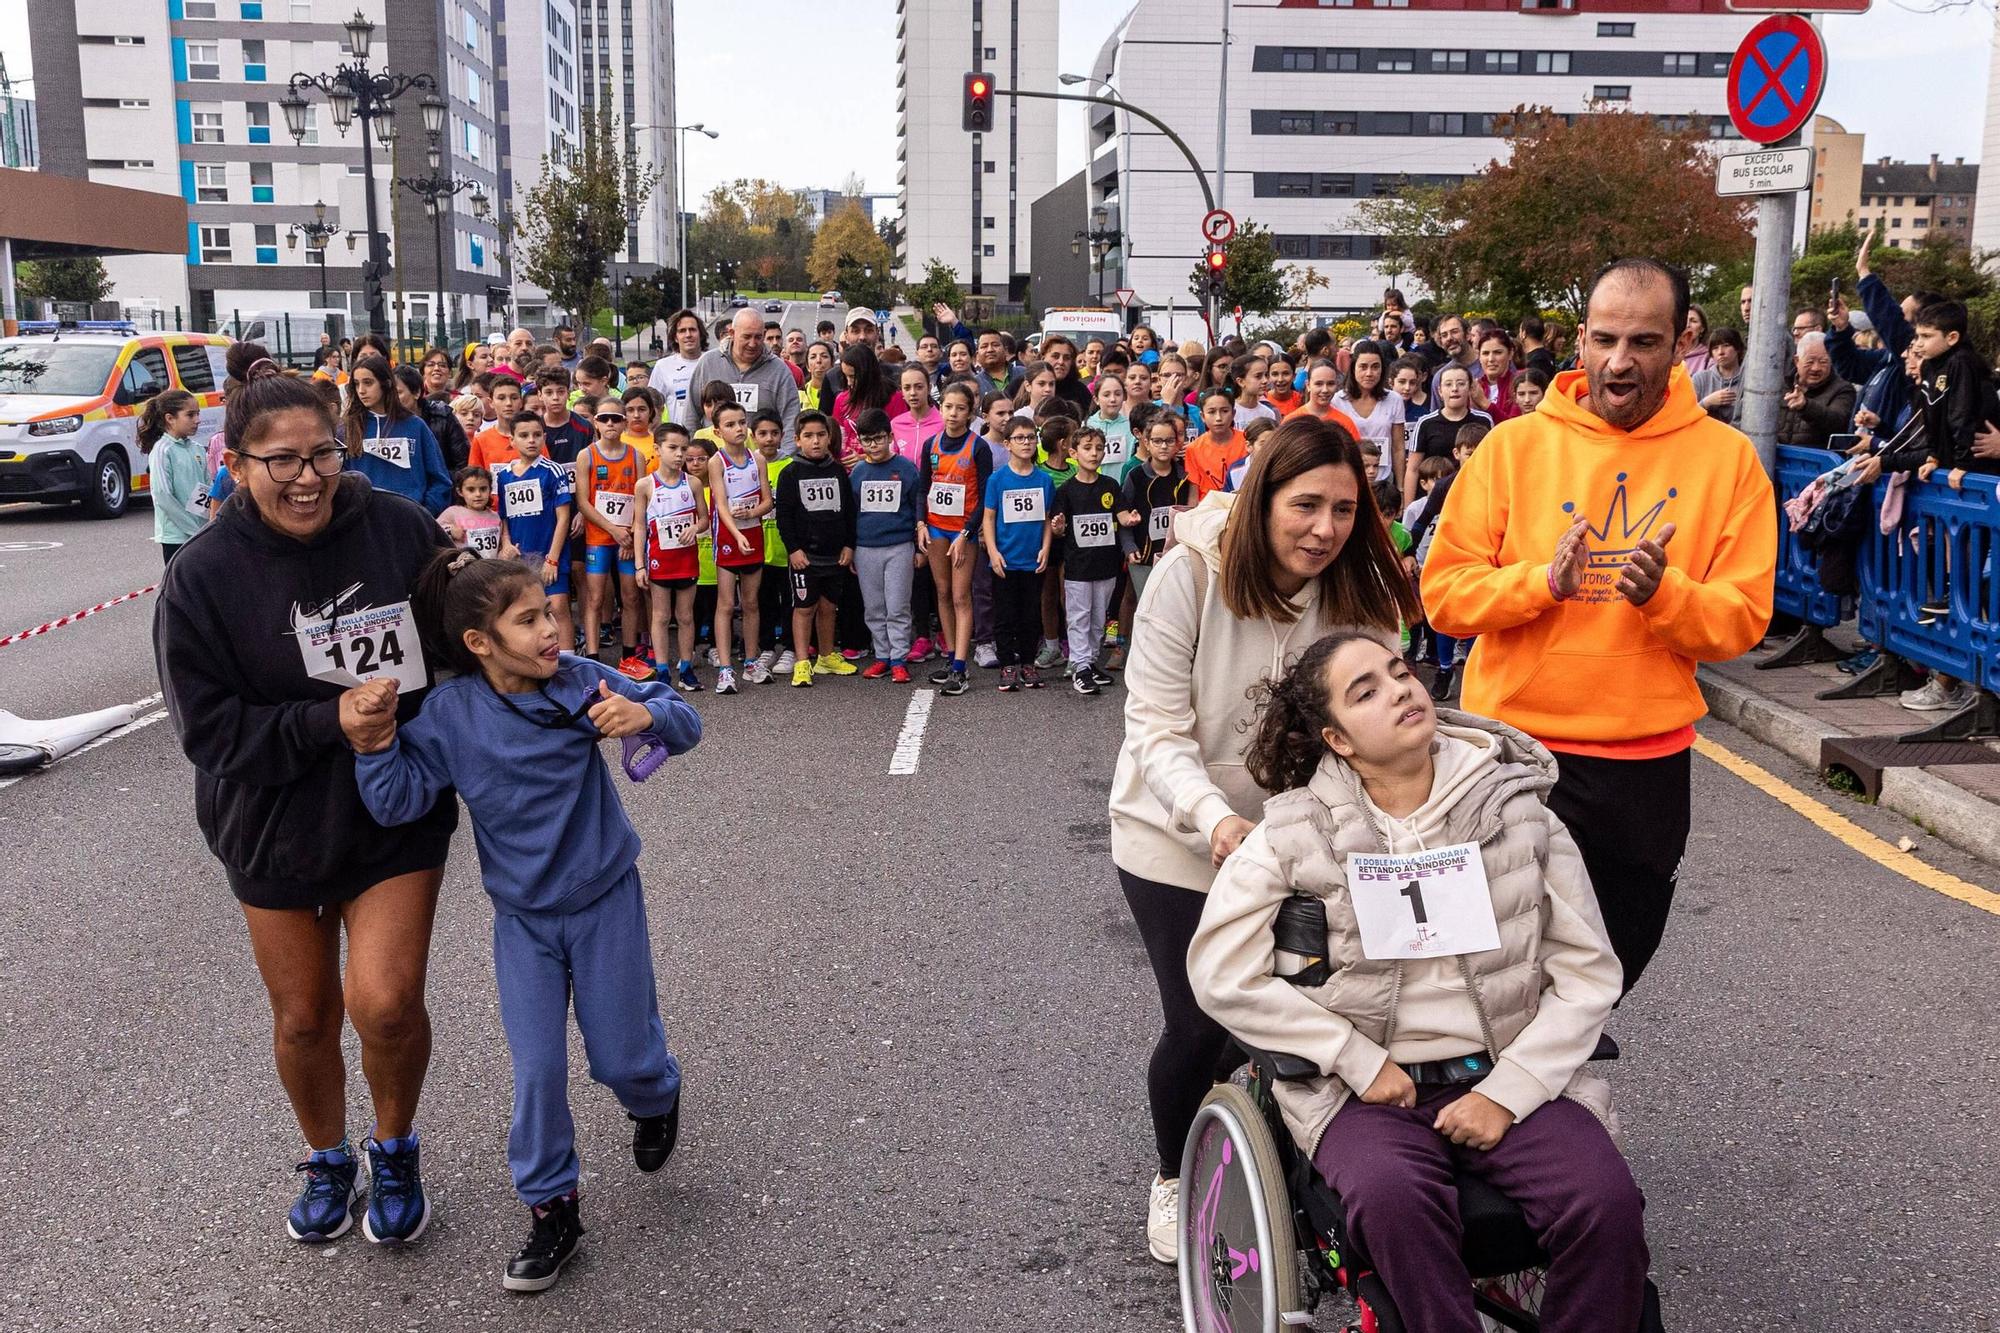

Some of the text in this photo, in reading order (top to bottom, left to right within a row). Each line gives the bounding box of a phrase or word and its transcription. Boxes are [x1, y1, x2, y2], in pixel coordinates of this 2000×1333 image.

[1745, 153, 1784, 165] EXCEPTO
[1733, 164, 1793, 178] BUS ESCOLAR
[1749, 179, 1773, 188] 5 min.
[509, 488, 534, 505] 340
[807, 487, 834, 501] 310
[867, 489, 894, 502] 313
[936, 491, 953, 506] 86
[606, 501, 625, 515] 87
[1014, 498, 1033, 512] 58
[1081, 523, 1108, 537] 299
[475, 536, 497, 550] 339
[341, 616, 364, 626] MILLA
[365, 607, 404, 620] SOLIDARIA
[311, 625, 352, 639] RETTNDO
[364, 613, 401, 627] SINDROME
[311, 619, 403, 646] DE RETT
[325, 630, 404, 675] 124
[1359, 856, 1466, 873] RETTANDO AL SINDROME
[1390, 857, 1416, 866] MILLA
[1419, 848, 1470, 863] SOLIDARIA
[1359, 863, 1468, 881] DE RETT
[1400, 880, 1427, 924] 1
